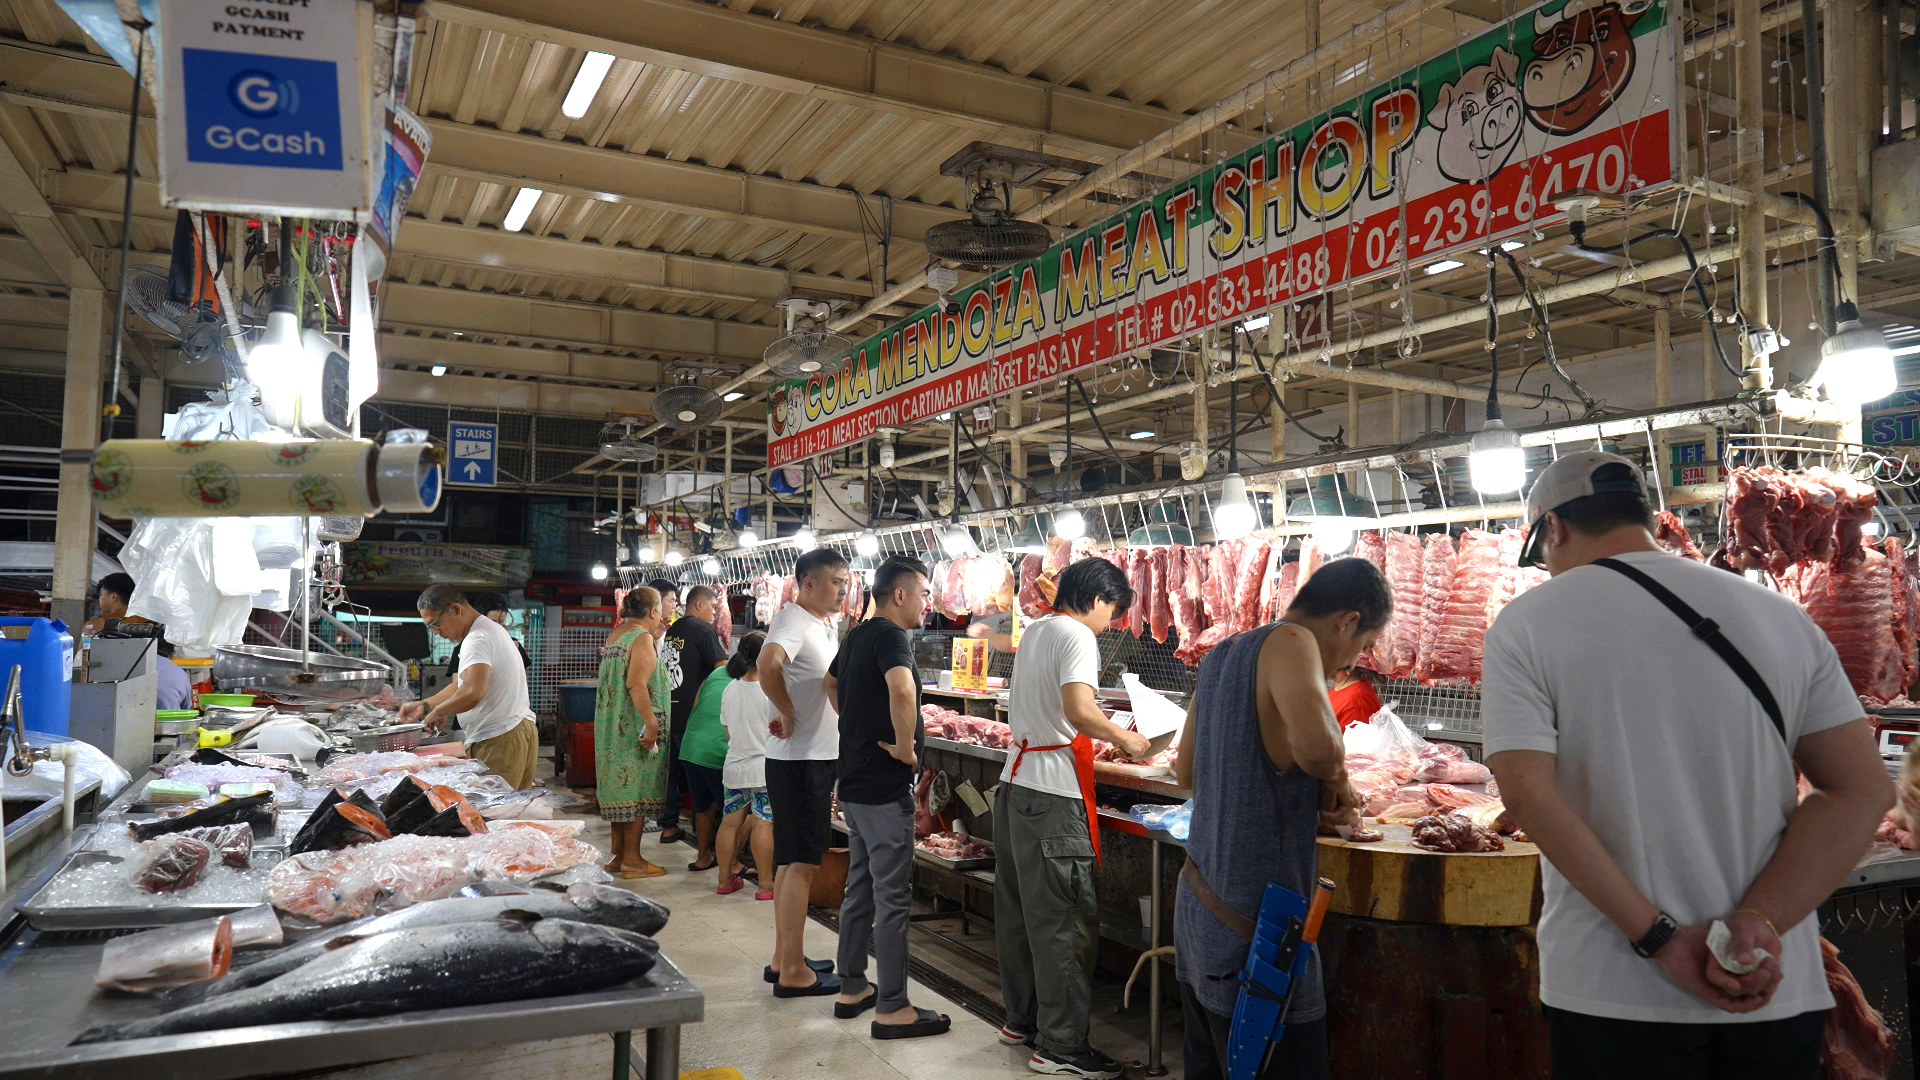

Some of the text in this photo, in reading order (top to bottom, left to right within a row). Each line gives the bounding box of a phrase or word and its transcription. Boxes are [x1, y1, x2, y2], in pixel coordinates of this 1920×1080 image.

[225, 5, 290, 22] GCASH
[212, 20, 305, 41] PAYMENT
[205, 125, 326, 156] GCash
[804, 83, 1424, 422] CORA MENDOZA MEAT SHOP
[773, 441, 793, 466] STALL
[800, 431, 831, 454] 116-121
[832, 420, 856, 445] MEAT
[857, 404, 899, 438] SECTION
[901, 379, 963, 422] CARTIMAR
[966, 356, 1023, 401] MARKET
[1028, 334, 1083, 381] PASAY
[1170, 244, 1330, 335] 02-833-4488
[1366, 144, 1626, 269] 02-239-6470
[455, 428, 493, 439] STAIRS
[1872, 412, 1920, 444] ST
[819, 455, 833, 477] 119
[1682, 467, 1707, 480] STAL
